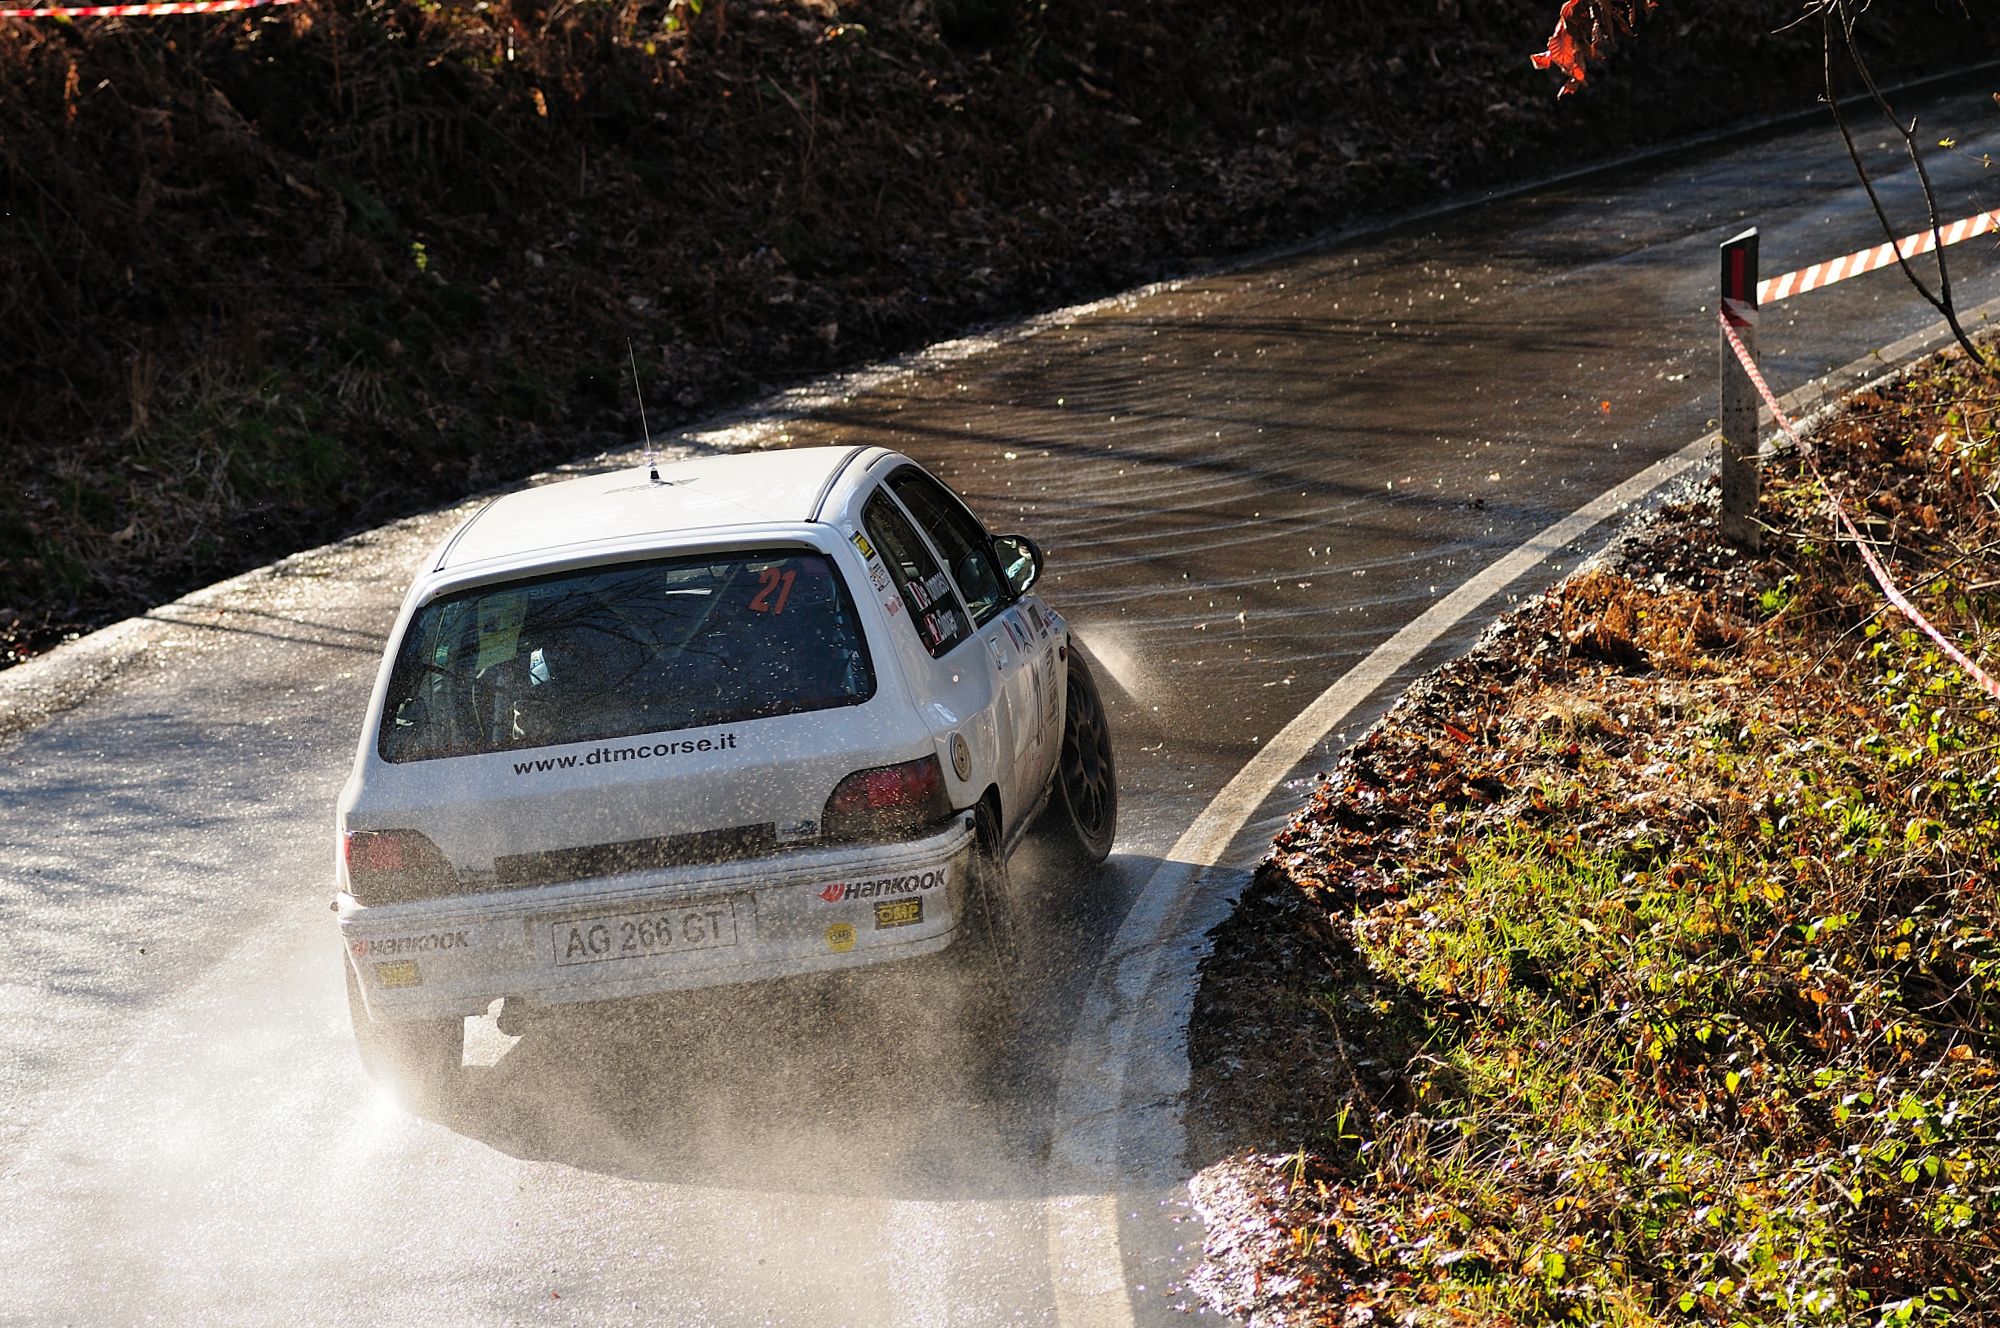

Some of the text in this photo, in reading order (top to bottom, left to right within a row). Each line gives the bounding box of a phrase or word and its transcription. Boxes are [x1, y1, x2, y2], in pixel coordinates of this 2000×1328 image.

[747, 567, 797, 614] 21
[513, 733, 737, 775] www.dtmcorse.it
[565, 910, 723, 958] AG 266 GT
[877, 902, 920, 923] OMP
